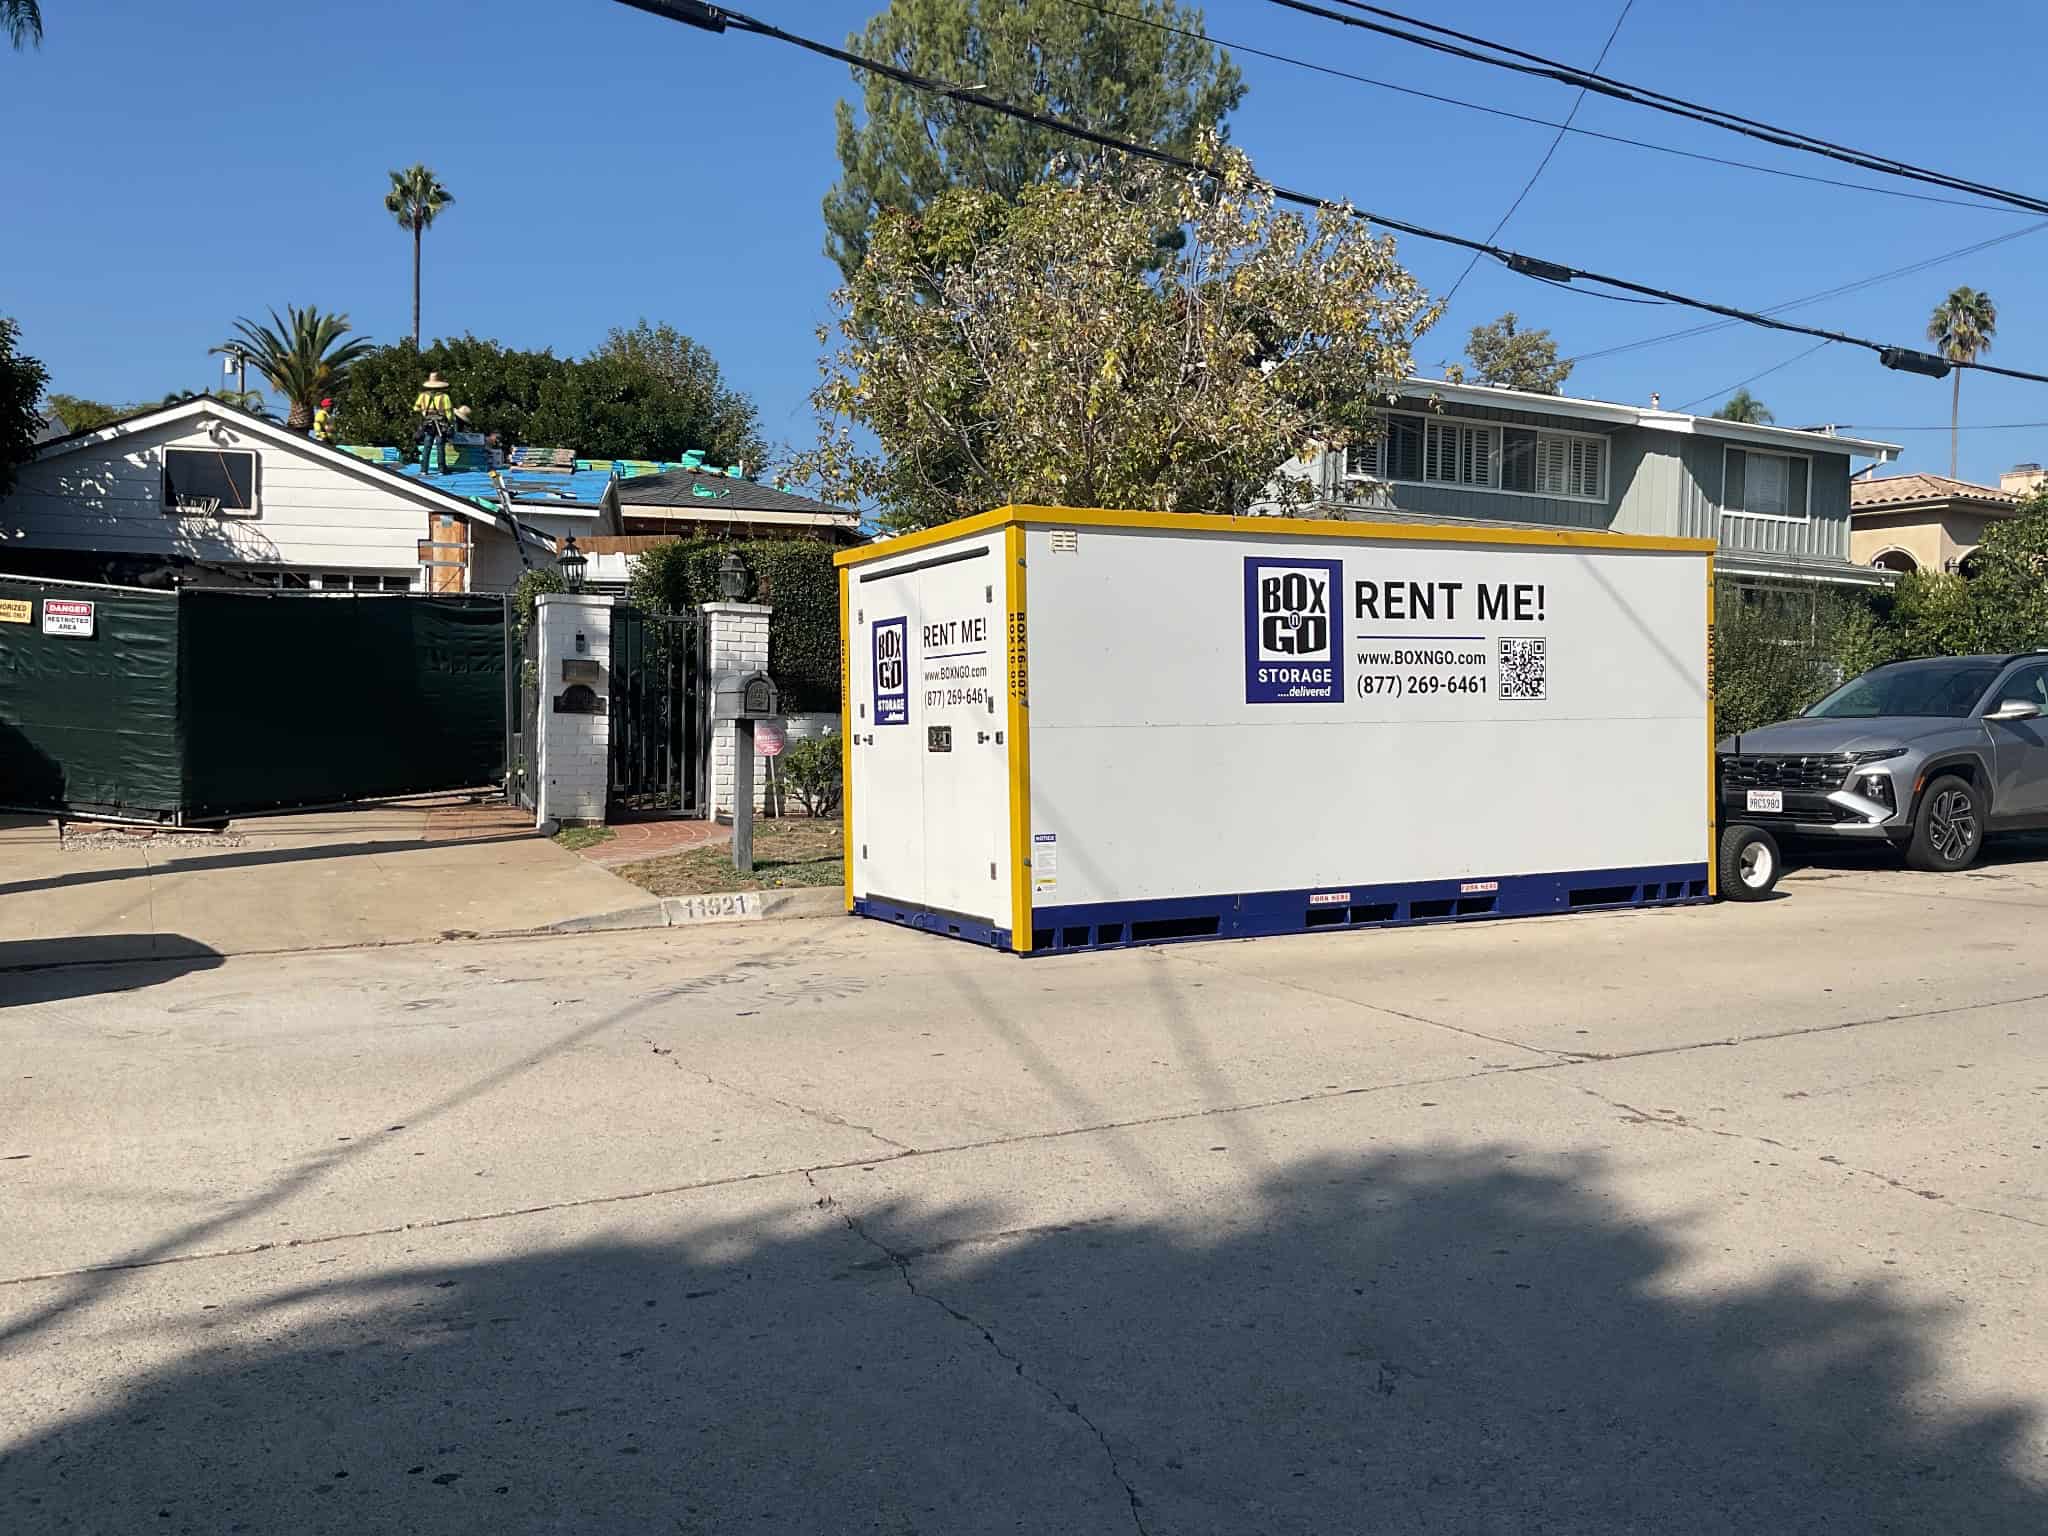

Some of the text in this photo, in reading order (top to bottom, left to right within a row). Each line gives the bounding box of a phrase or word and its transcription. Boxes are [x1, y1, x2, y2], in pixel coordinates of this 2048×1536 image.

[1262, 572, 1327, 613] BOX
[1355, 580, 1545, 621] RENT ME!
[49, 604, 88, 613] DANGER
[878, 629, 902, 661] BOX
[923, 617, 987, 648] RENT ME!
[1263, 615, 1327, 655] GO
[1017, 611, 1026, 698] BOX16-007
[1357, 650, 1487, 665] www.BOXNGO.com
[924, 665, 987, 681] www.BOXNGO.com
[1258, 668, 1332, 683] STORAGE
[1357, 675, 1487, 698] (877) 269-6461
[924, 688, 988, 711] (877) 269-6461
